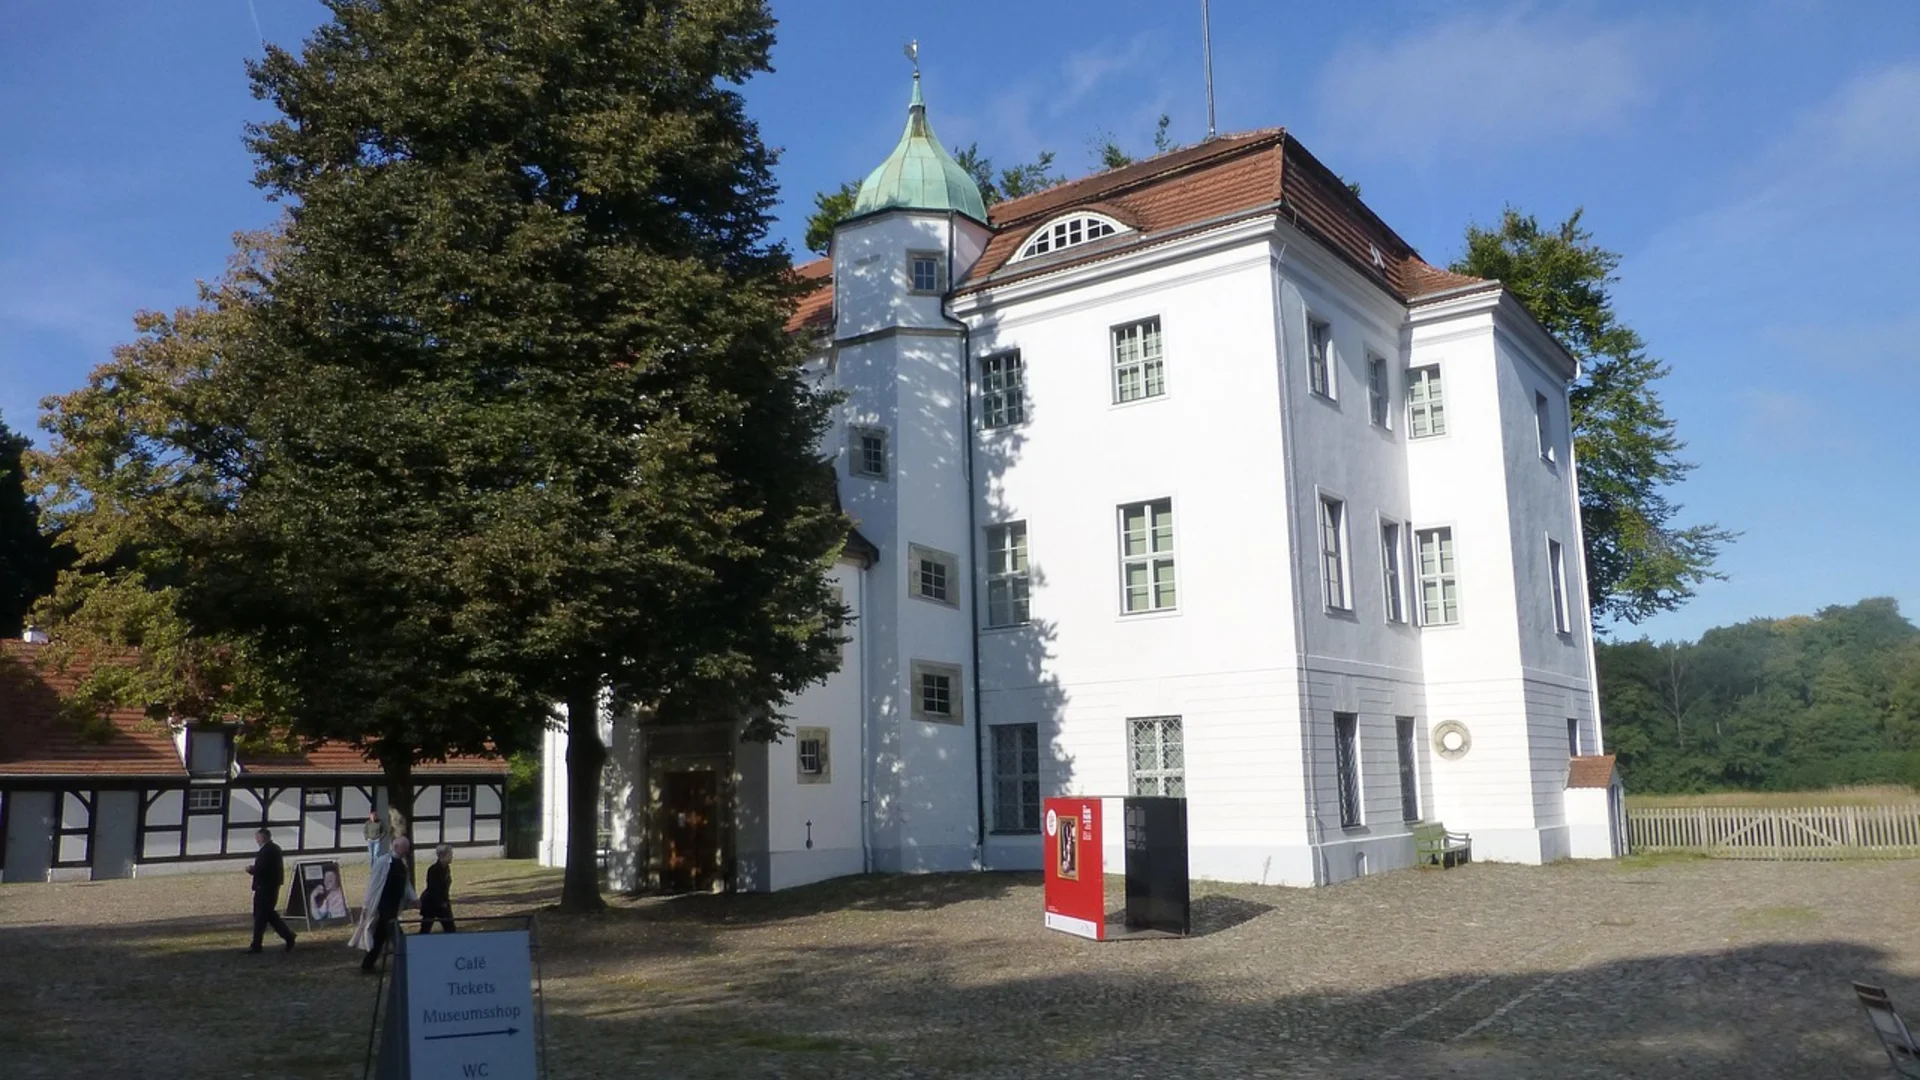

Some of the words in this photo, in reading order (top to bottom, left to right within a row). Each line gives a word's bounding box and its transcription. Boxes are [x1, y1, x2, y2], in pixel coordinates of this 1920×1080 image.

[455, 957, 486, 971] Café
[447, 981, 495, 996] Tickets
[423, 1005, 521, 1023] Museumsshop
[463, 1063, 489, 1078] WC
